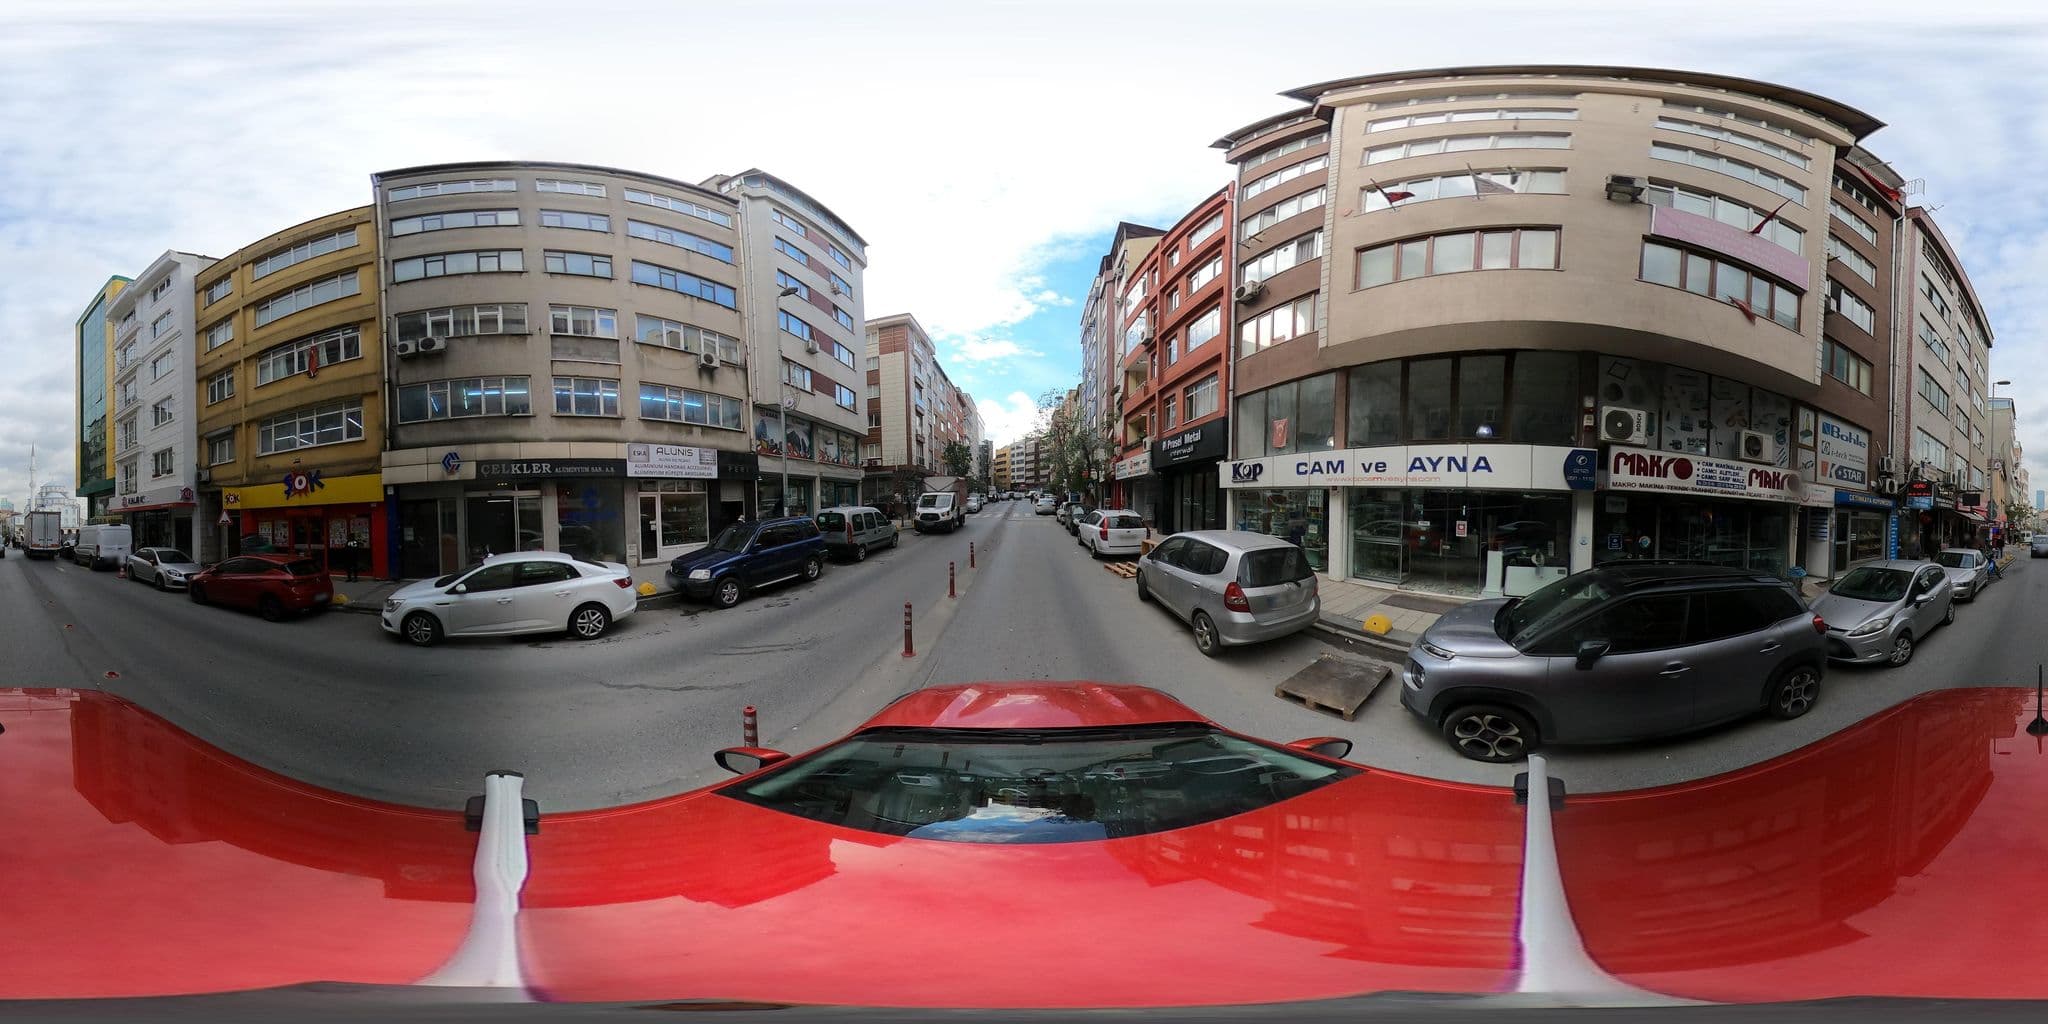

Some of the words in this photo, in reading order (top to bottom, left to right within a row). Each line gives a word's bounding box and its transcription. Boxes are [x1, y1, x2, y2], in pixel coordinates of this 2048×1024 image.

[1184, 429, 1201, 444] Metal
[1831, 424, 1867, 448] Bohle
[656, 447, 694, 457] ALUNIS
[481, 463, 552, 477] ÇELKLER
[1296, 459, 1345, 475] CAM
[1361, 461, 1387, 473] ve
[1408, 456, 1493, 473] AYNA
